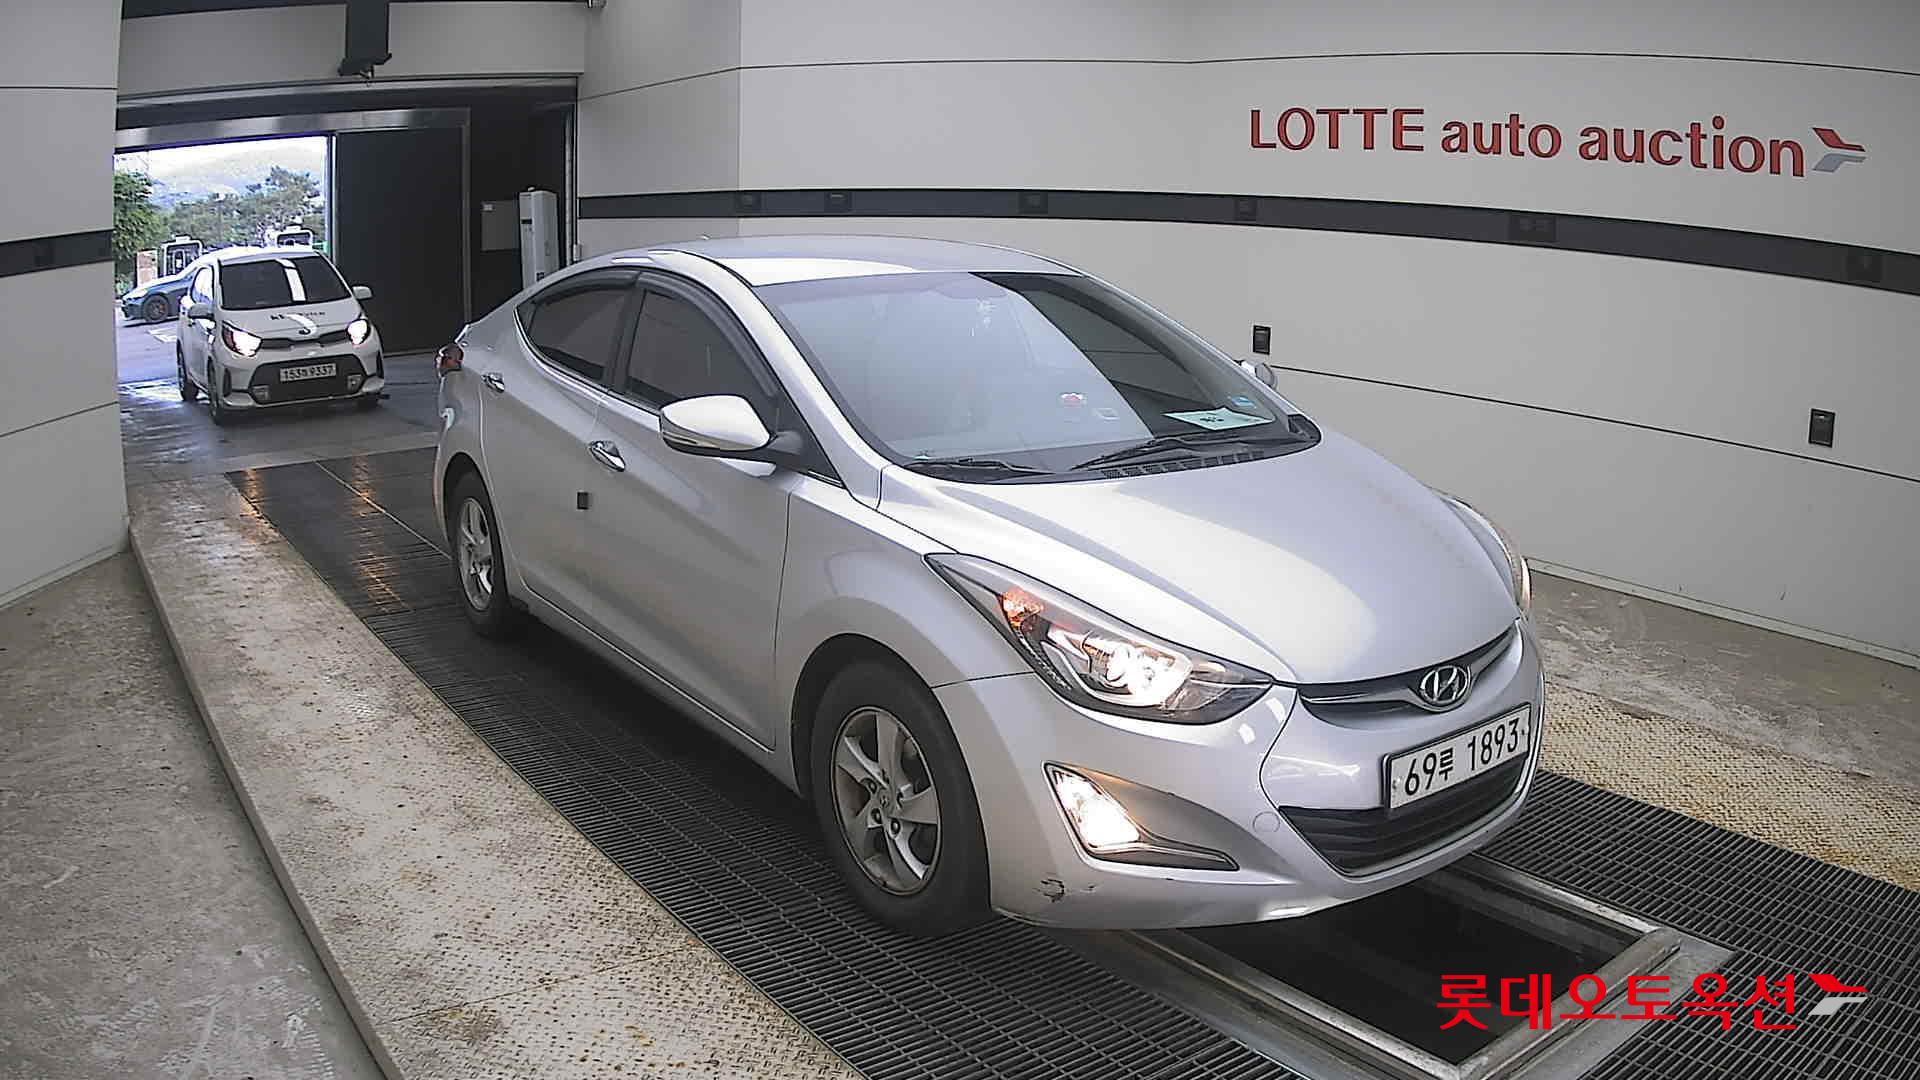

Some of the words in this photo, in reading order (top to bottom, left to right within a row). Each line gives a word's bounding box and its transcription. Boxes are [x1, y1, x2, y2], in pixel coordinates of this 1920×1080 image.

[1251, 108, 1425, 152] LOTTE
[1441, 113, 1562, 157] auto
[1578, 115, 1805, 177] auction
[1404, 748, 1453, 796] 69루
[1467, 717, 1520, 771] 1893
